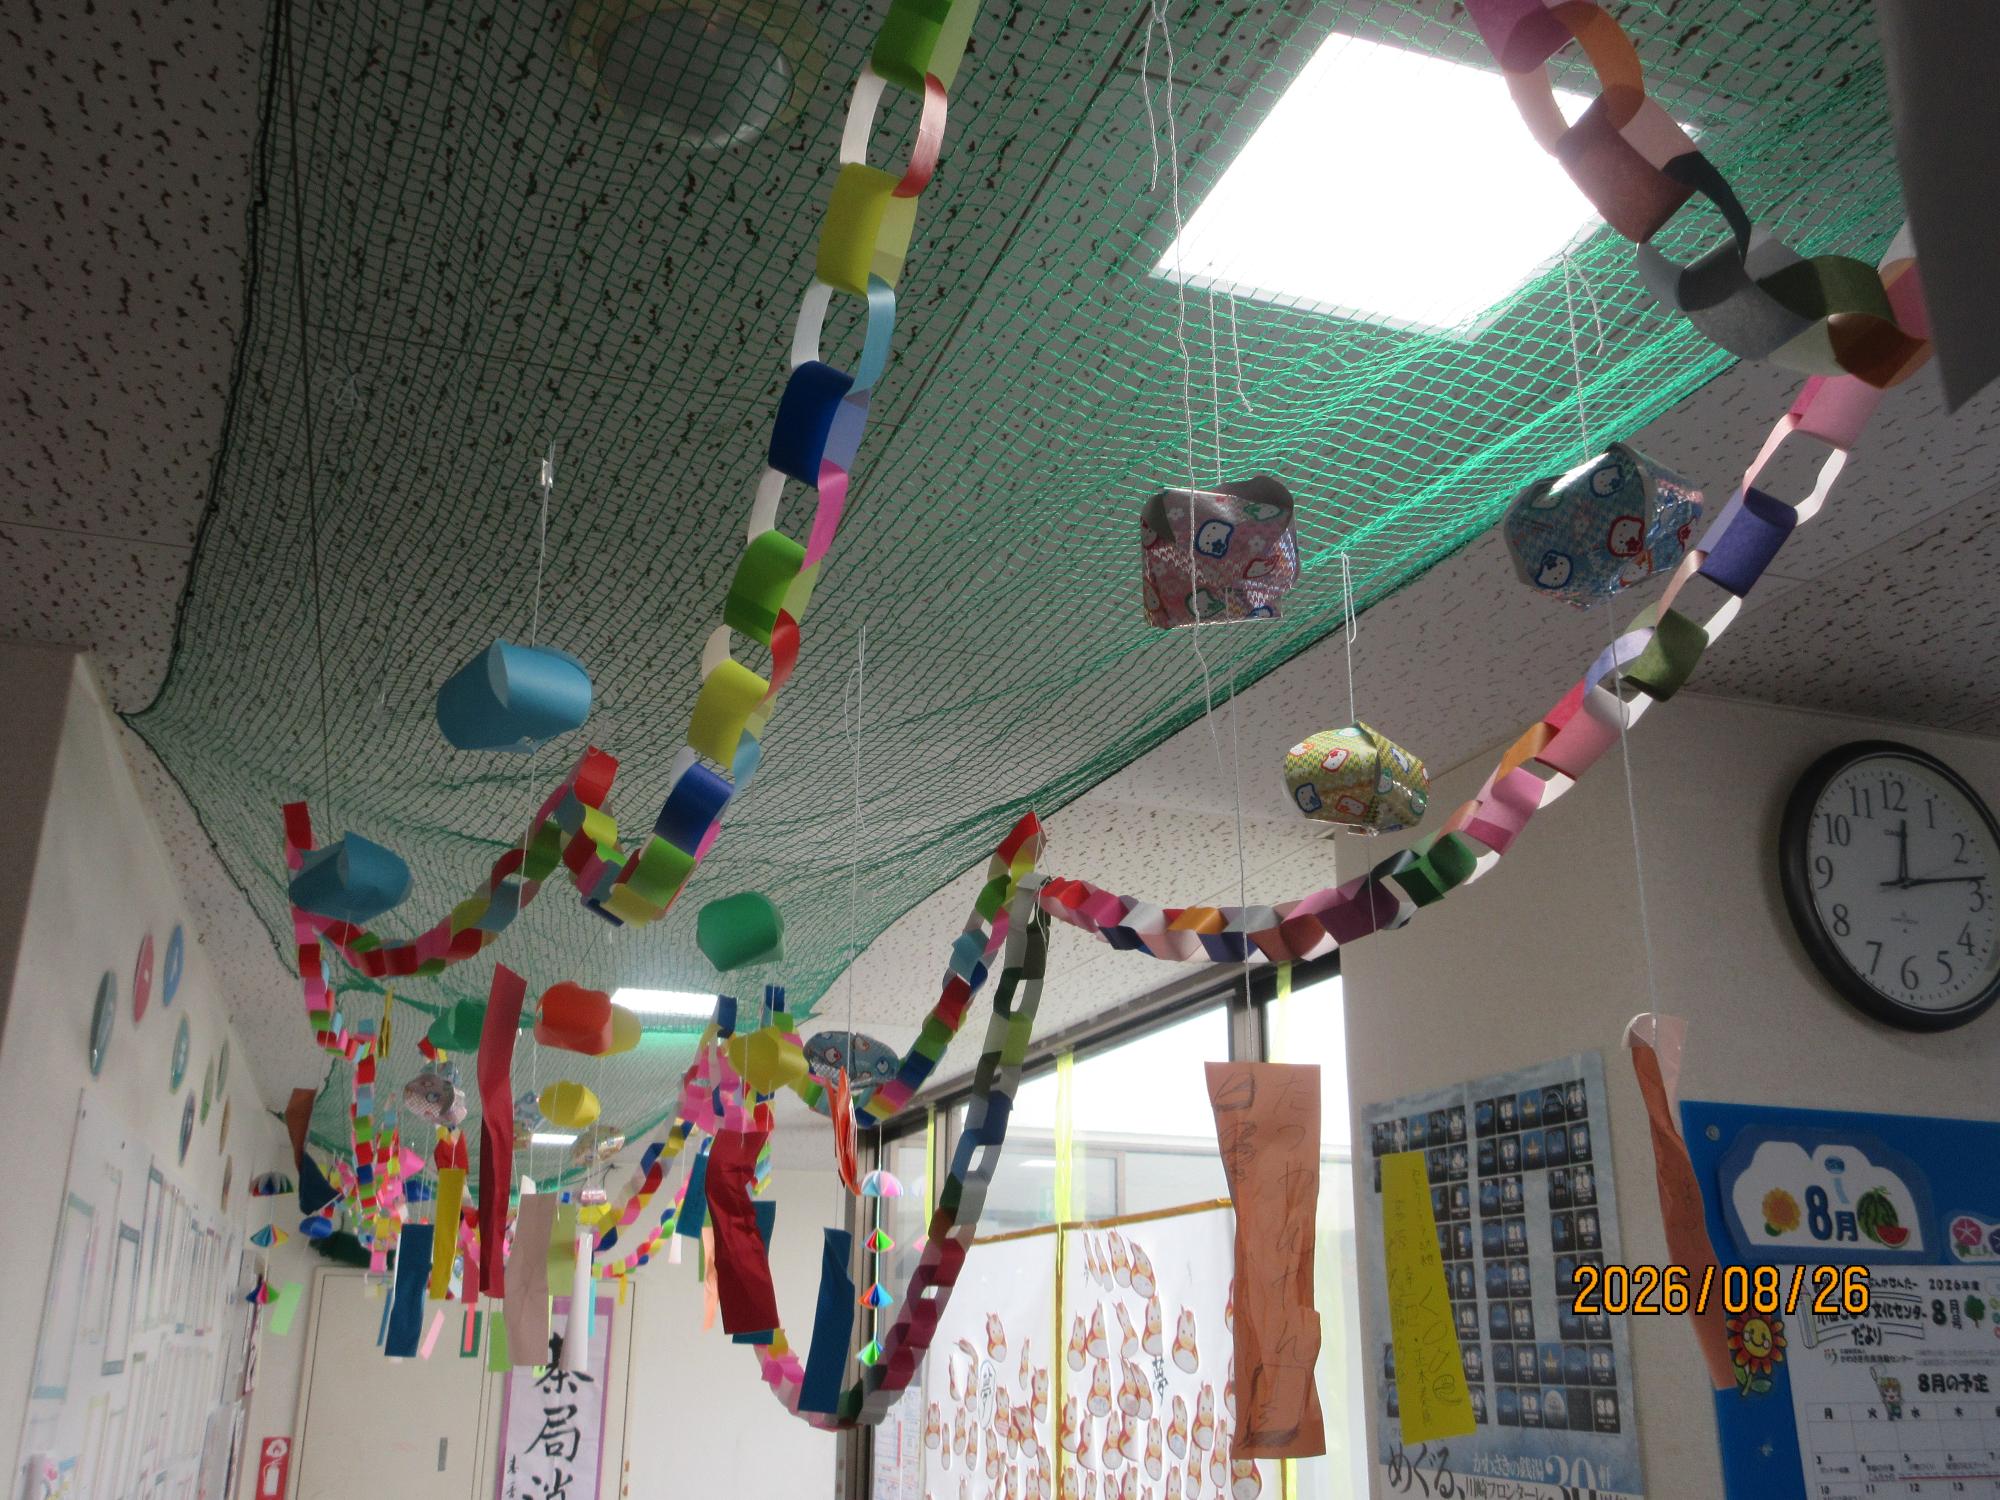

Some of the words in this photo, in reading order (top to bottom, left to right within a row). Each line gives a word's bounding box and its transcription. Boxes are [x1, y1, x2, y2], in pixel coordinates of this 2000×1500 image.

[1849, 786, 1874, 820] 11
[1880, 779, 1908, 813] 12
[1824, 812, 1851, 847] 10
[1924, 798, 1937, 830] 1
[1951, 832, 1969, 865] 2
[1815, 855, 1834, 890] 9
[1967, 879, 1986, 914] 3
[1832, 903, 1851, 937] 8
[1956, 921, 1975, 957] 4
[1865, 940, 1883, 975] 7
[1900, 954, 1919, 991] 6
[1936, 950, 1954, 985] 5
[1804, 1185, 1860, 1243] 8月
[1851, 1323, 1883, 1346] だより
[1917, 1372, 1990, 1394] 8月の予定
[1389, 1442, 1465, 1500] めぐる、
